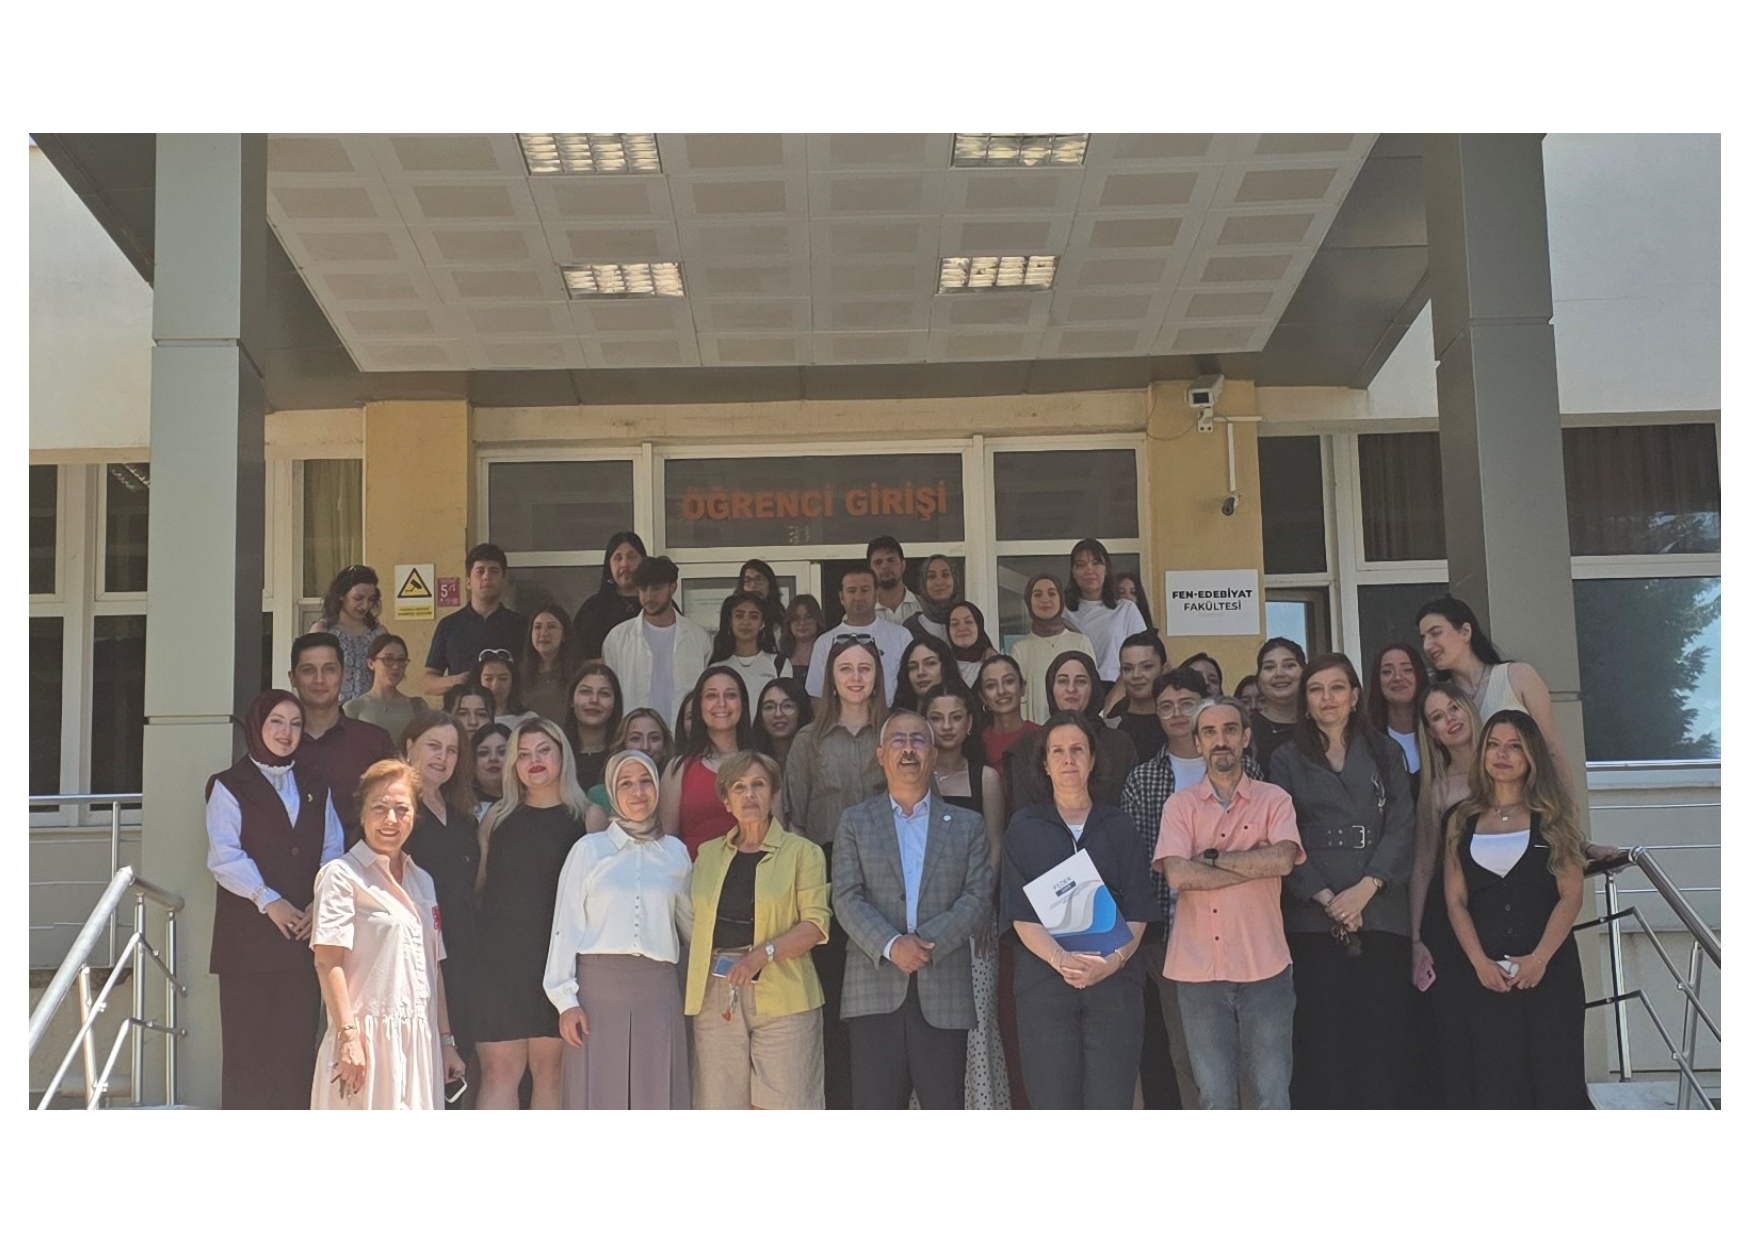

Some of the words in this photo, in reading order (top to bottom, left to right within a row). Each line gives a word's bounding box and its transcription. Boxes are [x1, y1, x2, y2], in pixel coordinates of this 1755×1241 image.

[682, 484, 833, 520] ÖĞRENCİ
[845, 480, 947, 521] GİRİŞİ
[1172, 587, 1253, 599] FEN-EDEBİYAT
[1183, 600, 1242, 612] FAKÜLTESİ
